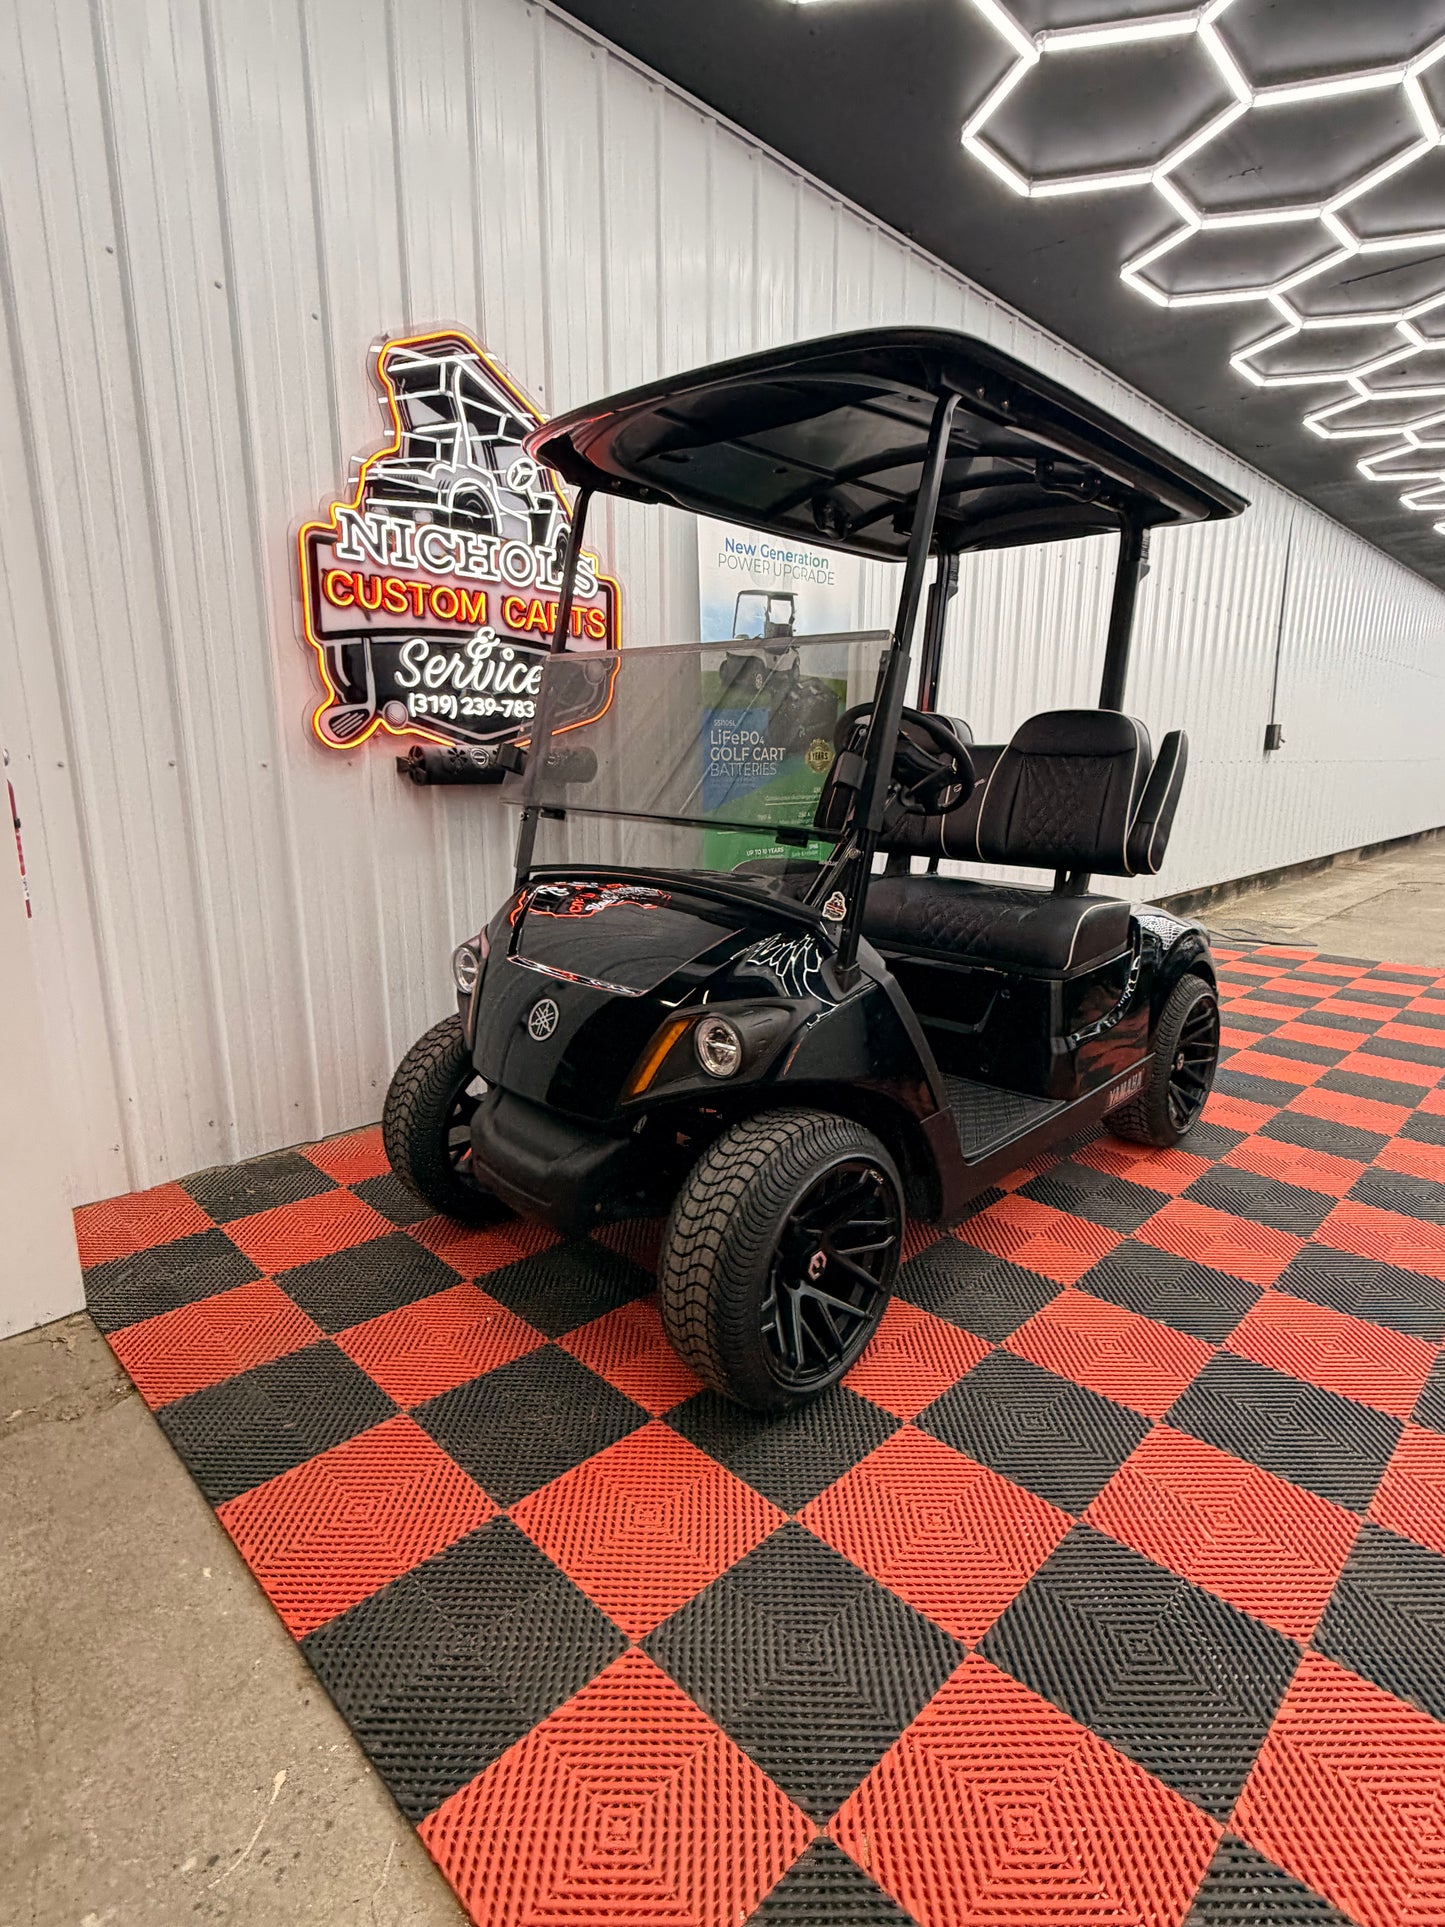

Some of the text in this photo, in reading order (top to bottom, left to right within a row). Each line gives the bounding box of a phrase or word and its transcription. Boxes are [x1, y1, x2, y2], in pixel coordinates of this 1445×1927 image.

[336, 507, 599, 599] NICHOLS
[718, 553, 835, 585] POWER UPGRADE
[725, 537, 829, 569] New Generation
[323, 569, 488, 625] CUSTOM
[466, 626, 500, 664] &
[394, 637, 544, 695] Service
[408, 692, 537, 719] (319) 239-783
[710, 747, 786, 761] GOLF CART
[710, 762, 777, 777] BATTERIES
